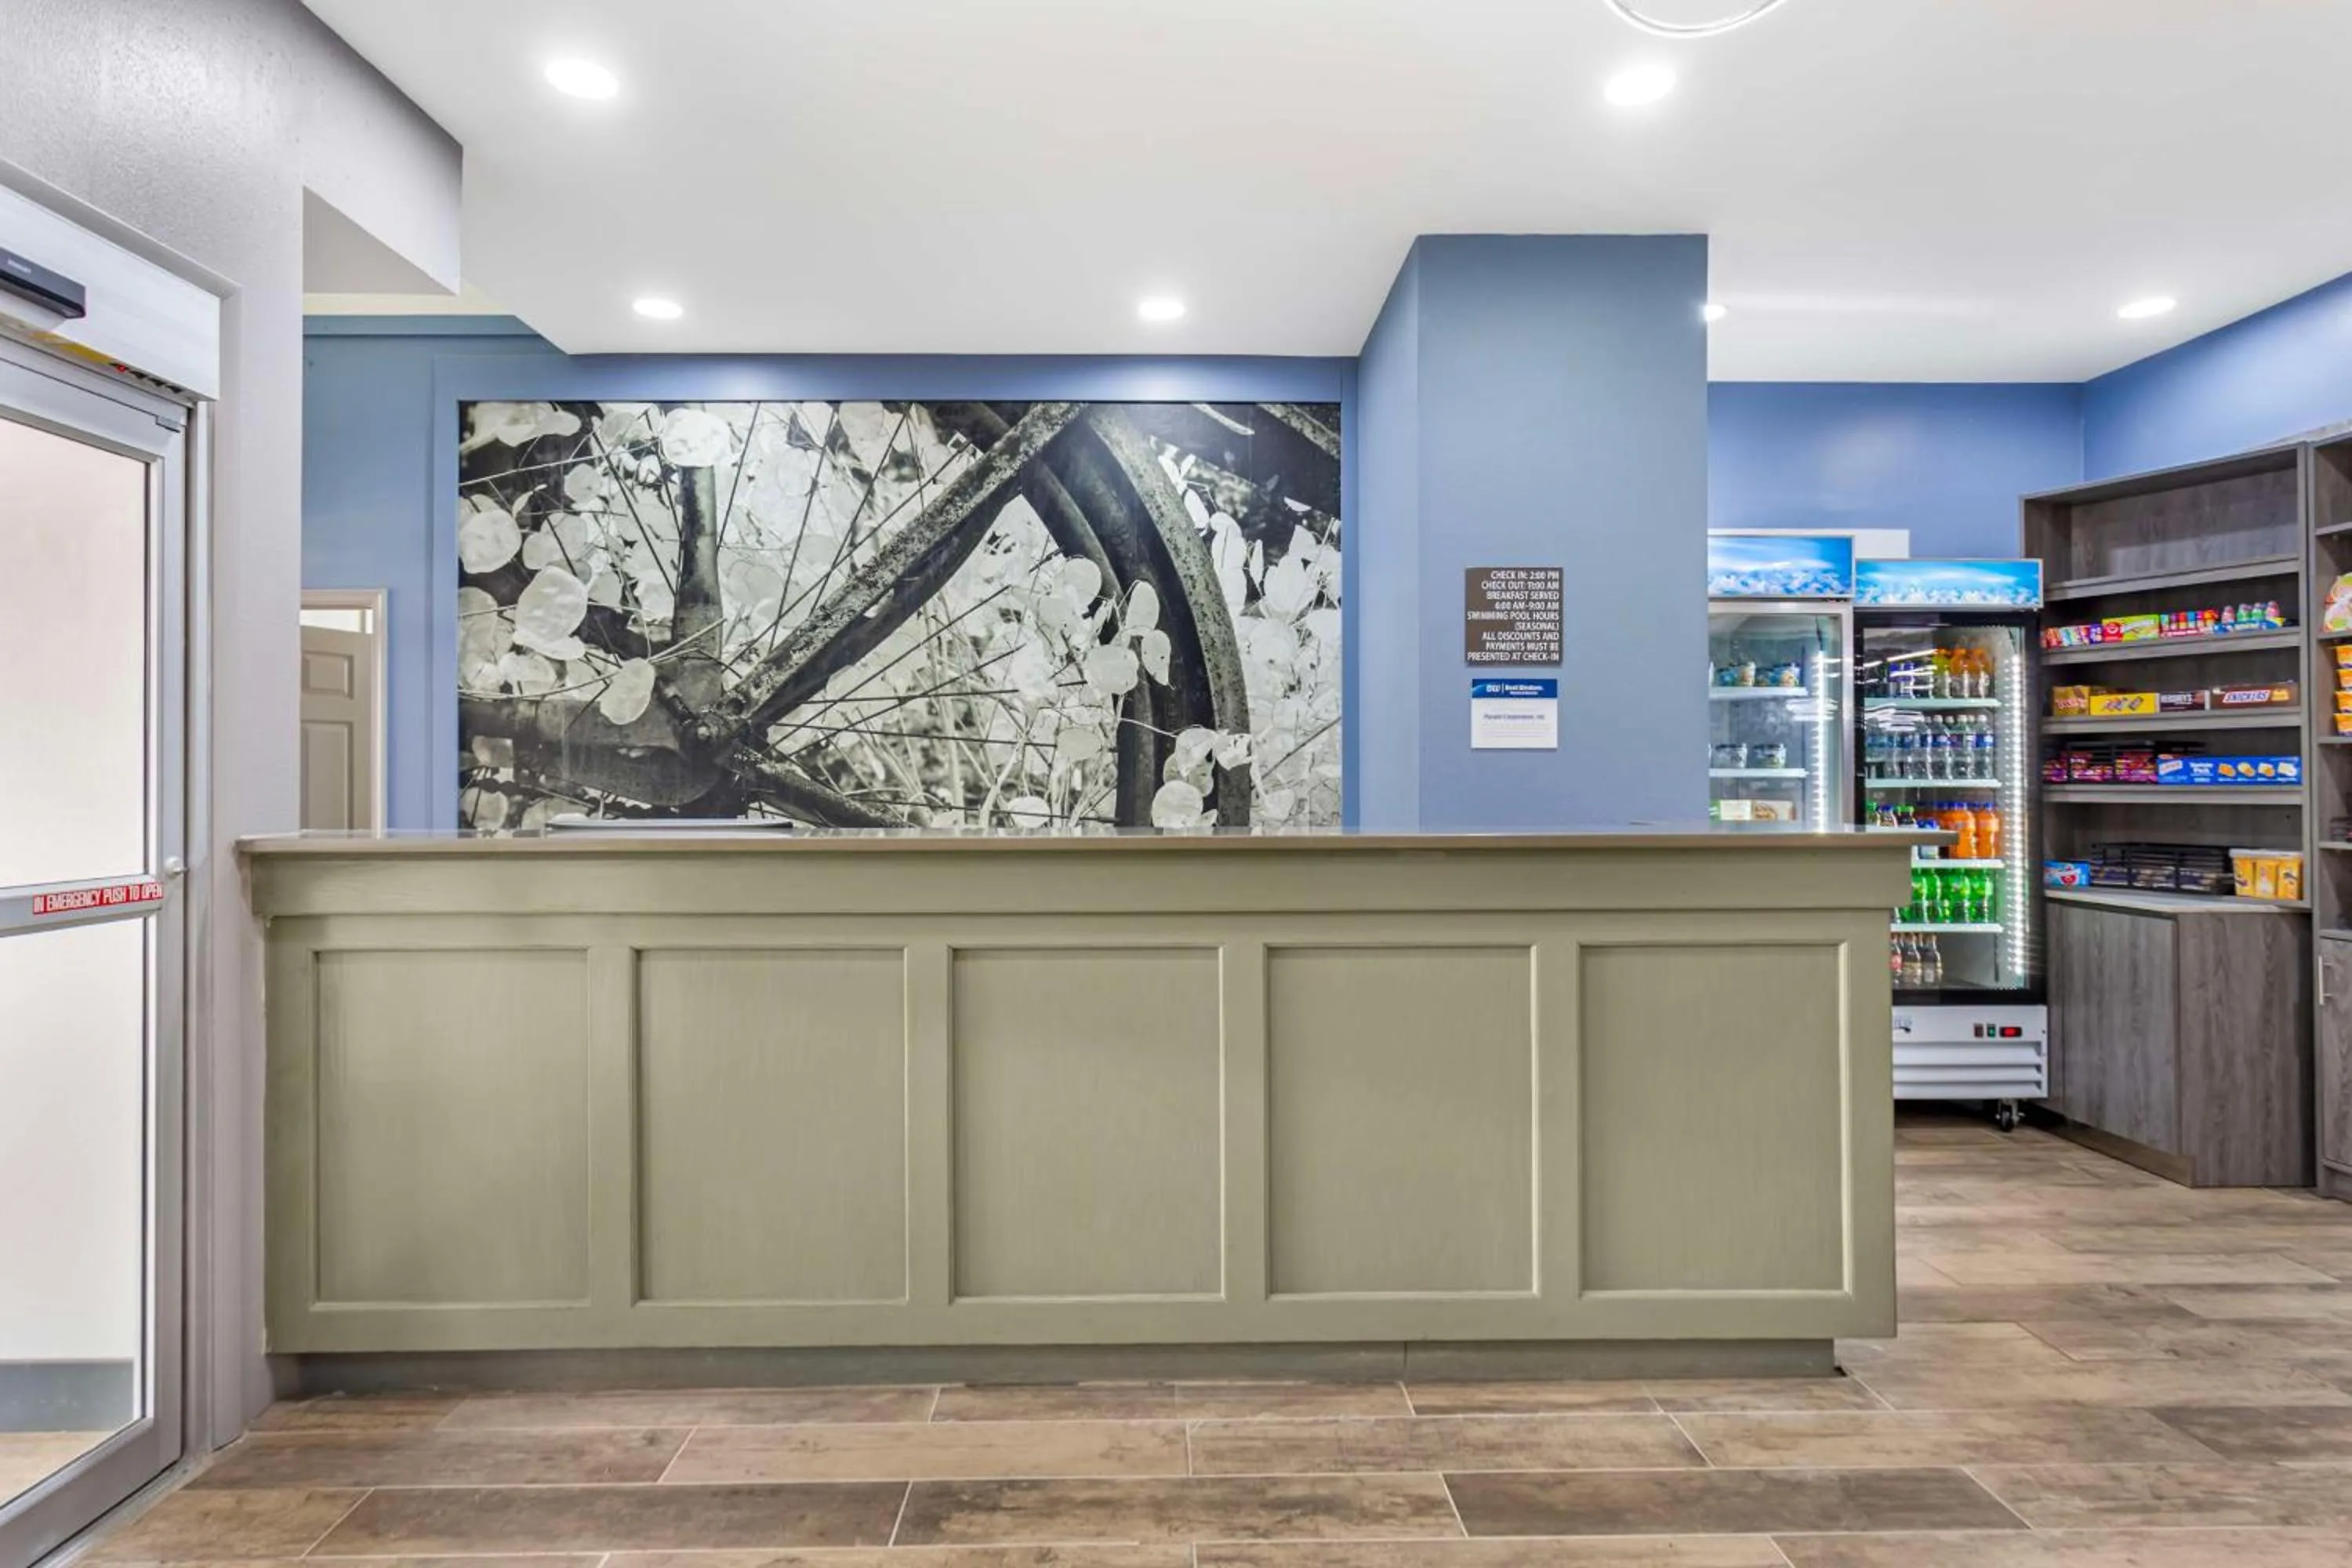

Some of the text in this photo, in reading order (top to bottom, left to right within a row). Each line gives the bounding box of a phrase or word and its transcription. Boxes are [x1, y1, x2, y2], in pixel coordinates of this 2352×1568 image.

[1490, 571, 1516, 579] CHECK
[1548, 571, 1559, 579] PM
[1481, 581, 1506, 590] CHECK
[1528, 581, 1544, 590] 11:00
[1547, 581, 1559, 590] AM
[1486, 591, 1559, 600] BREAKFAST SERVED
[1547, 601, 1559, 610] AM
[1467, 611, 1559, 620] SWIMMING POOL HOURS
[1514, 622, 1559, 630] (SEASONAL)
[1482, 631, 1559, 641] ALL DISCOUNTS AND
[1486, 641, 1559, 651] PAYMENTS MUST BE
[1467, 652, 1559, 661] PRESENTED AT CHECK-IN
[2226, 690, 2268, 702] SNICKERS
[34, 883, 162, 913] IN EMERGENCY PUSH TO OPEN
